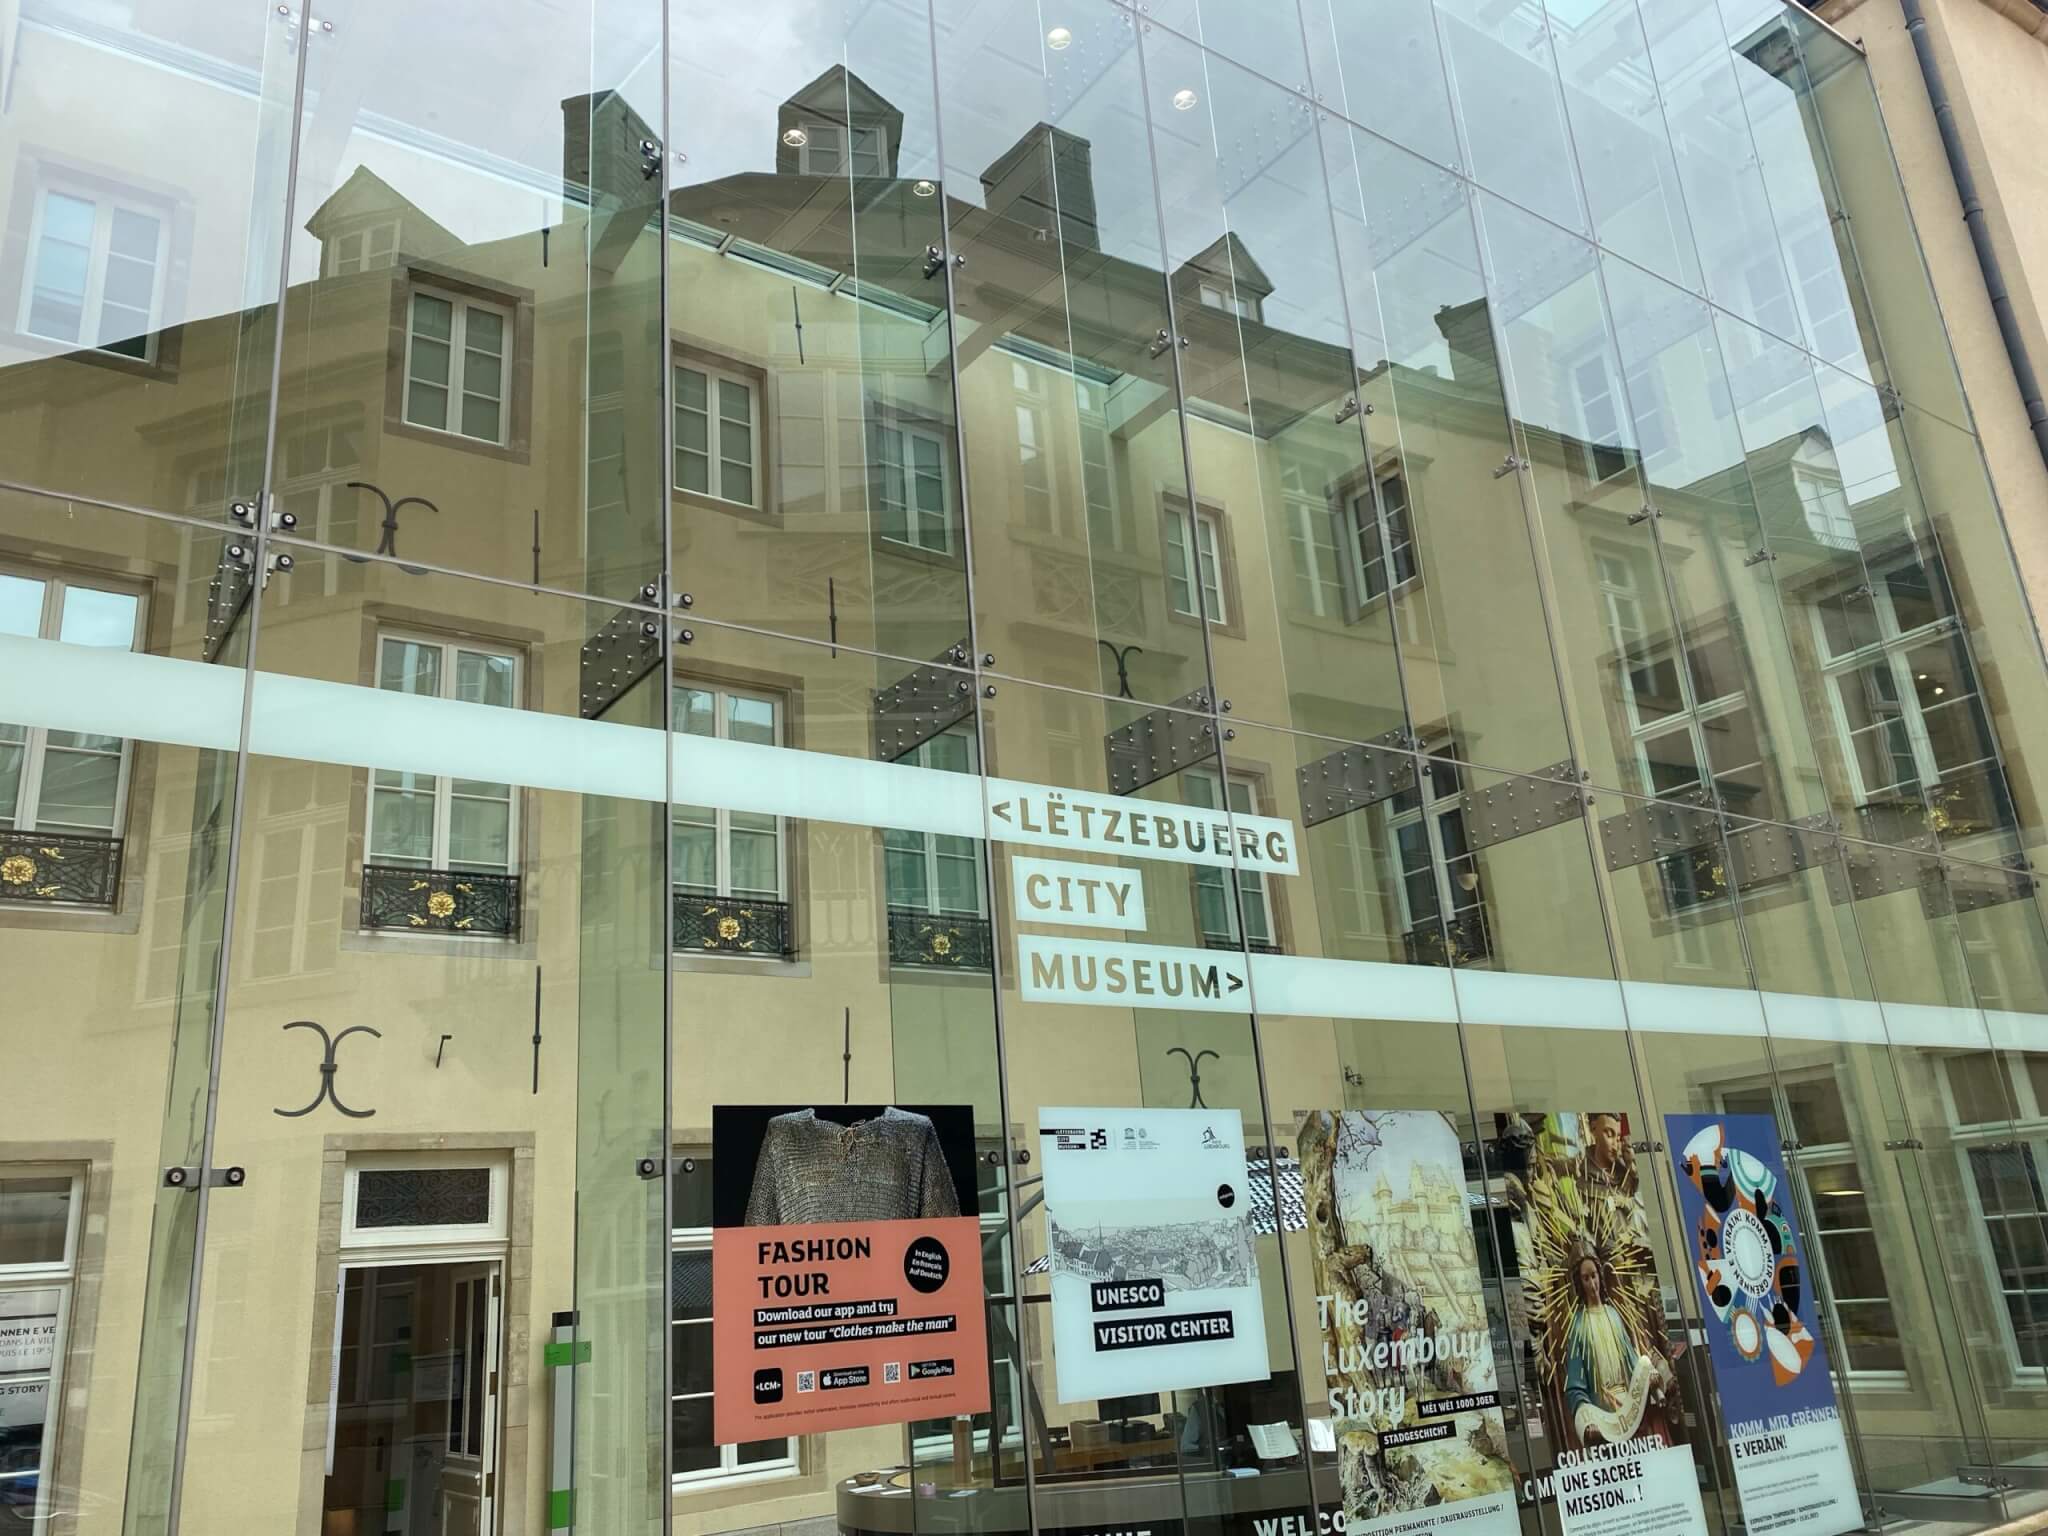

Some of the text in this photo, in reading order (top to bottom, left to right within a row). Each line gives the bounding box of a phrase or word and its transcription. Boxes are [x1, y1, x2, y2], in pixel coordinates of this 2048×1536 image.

[1026, 874, 1132, 916] CITY
[758, 1237, 871, 1264] FASHION
[758, 1273, 830, 1298] TOUR
[1096, 1285, 1160, 1305] UNESCO
[757, 1301, 894, 1323] Download our app and try
[1315, 1291, 1369, 1330] The
[758, 1333, 777, 1345] our
[779, 1331, 802, 1343] new
[803, 1329, 827, 1341] tour
[875, 1321, 905, 1335] make
[906, 1319, 924, 1332] the
[1099, 1318, 1231, 1345] VISITOR CENTER
[833, 1375, 867, 1386] App Store
[921, 1366, 953, 1377] Google Play
[8, 1384, 44, 1395] STORY
[1328, 1386, 1405, 1431] Story
[1456, 1398, 1475, 1410] 1000
[1476, 1395, 1496, 1407] JOER
[1384, 1425, 1449, 1445] STADGESCHICHT
[1769, 1414, 1791, 1432] MIR
[1734, 1443, 1742, 1459] E
[1743, 1434, 1788, 1457] VERÄIN!
[1561, 1471, 1590, 1493] UNE
[1592, 1458, 1644, 1487] SACRÉE
[1394, 1518, 1436, 1535] PERMANENTE
[1440, 1504, 1501, 1524] DAUERAUSSTELLUNG
